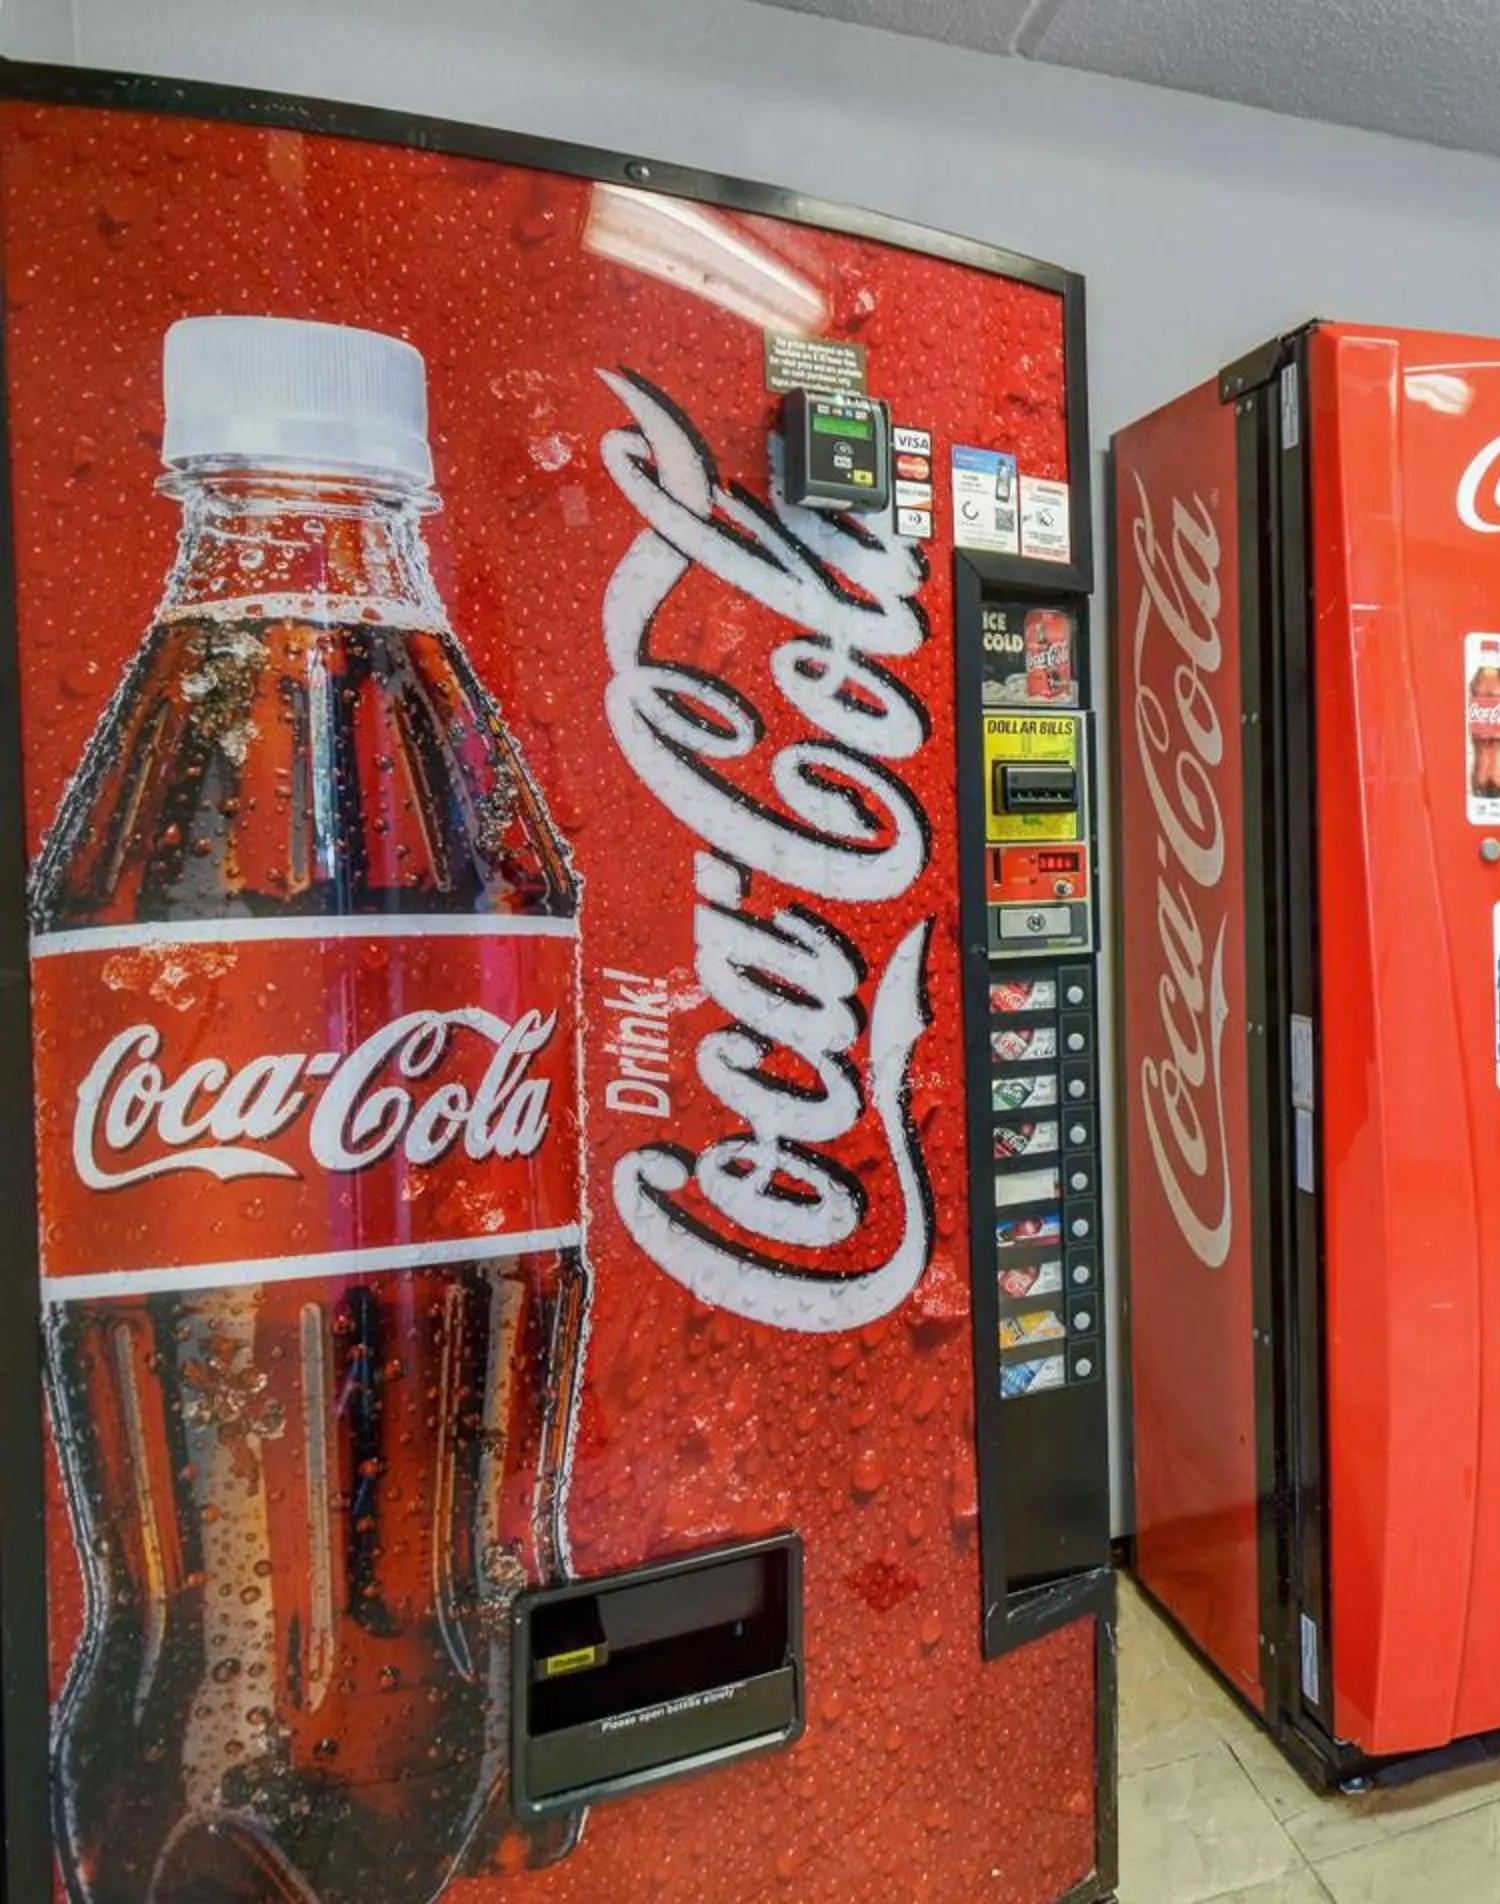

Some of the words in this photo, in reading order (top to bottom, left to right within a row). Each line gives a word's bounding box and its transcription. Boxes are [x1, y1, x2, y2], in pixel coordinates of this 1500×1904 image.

[898, 435, 929, 450] VISA
[982, 611, 1007, 631] ICE
[983, 632, 1024, 653] COLD
[988, 719, 1037, 735] DOLLAR
[1039, 721, 1073, 735] BILLS
[1133, 467, 1231, 1268] Coca-Cola
[602, 968, 671, 1118] Drink!
[73, 1007, 557, 1191] Coca-Cola
